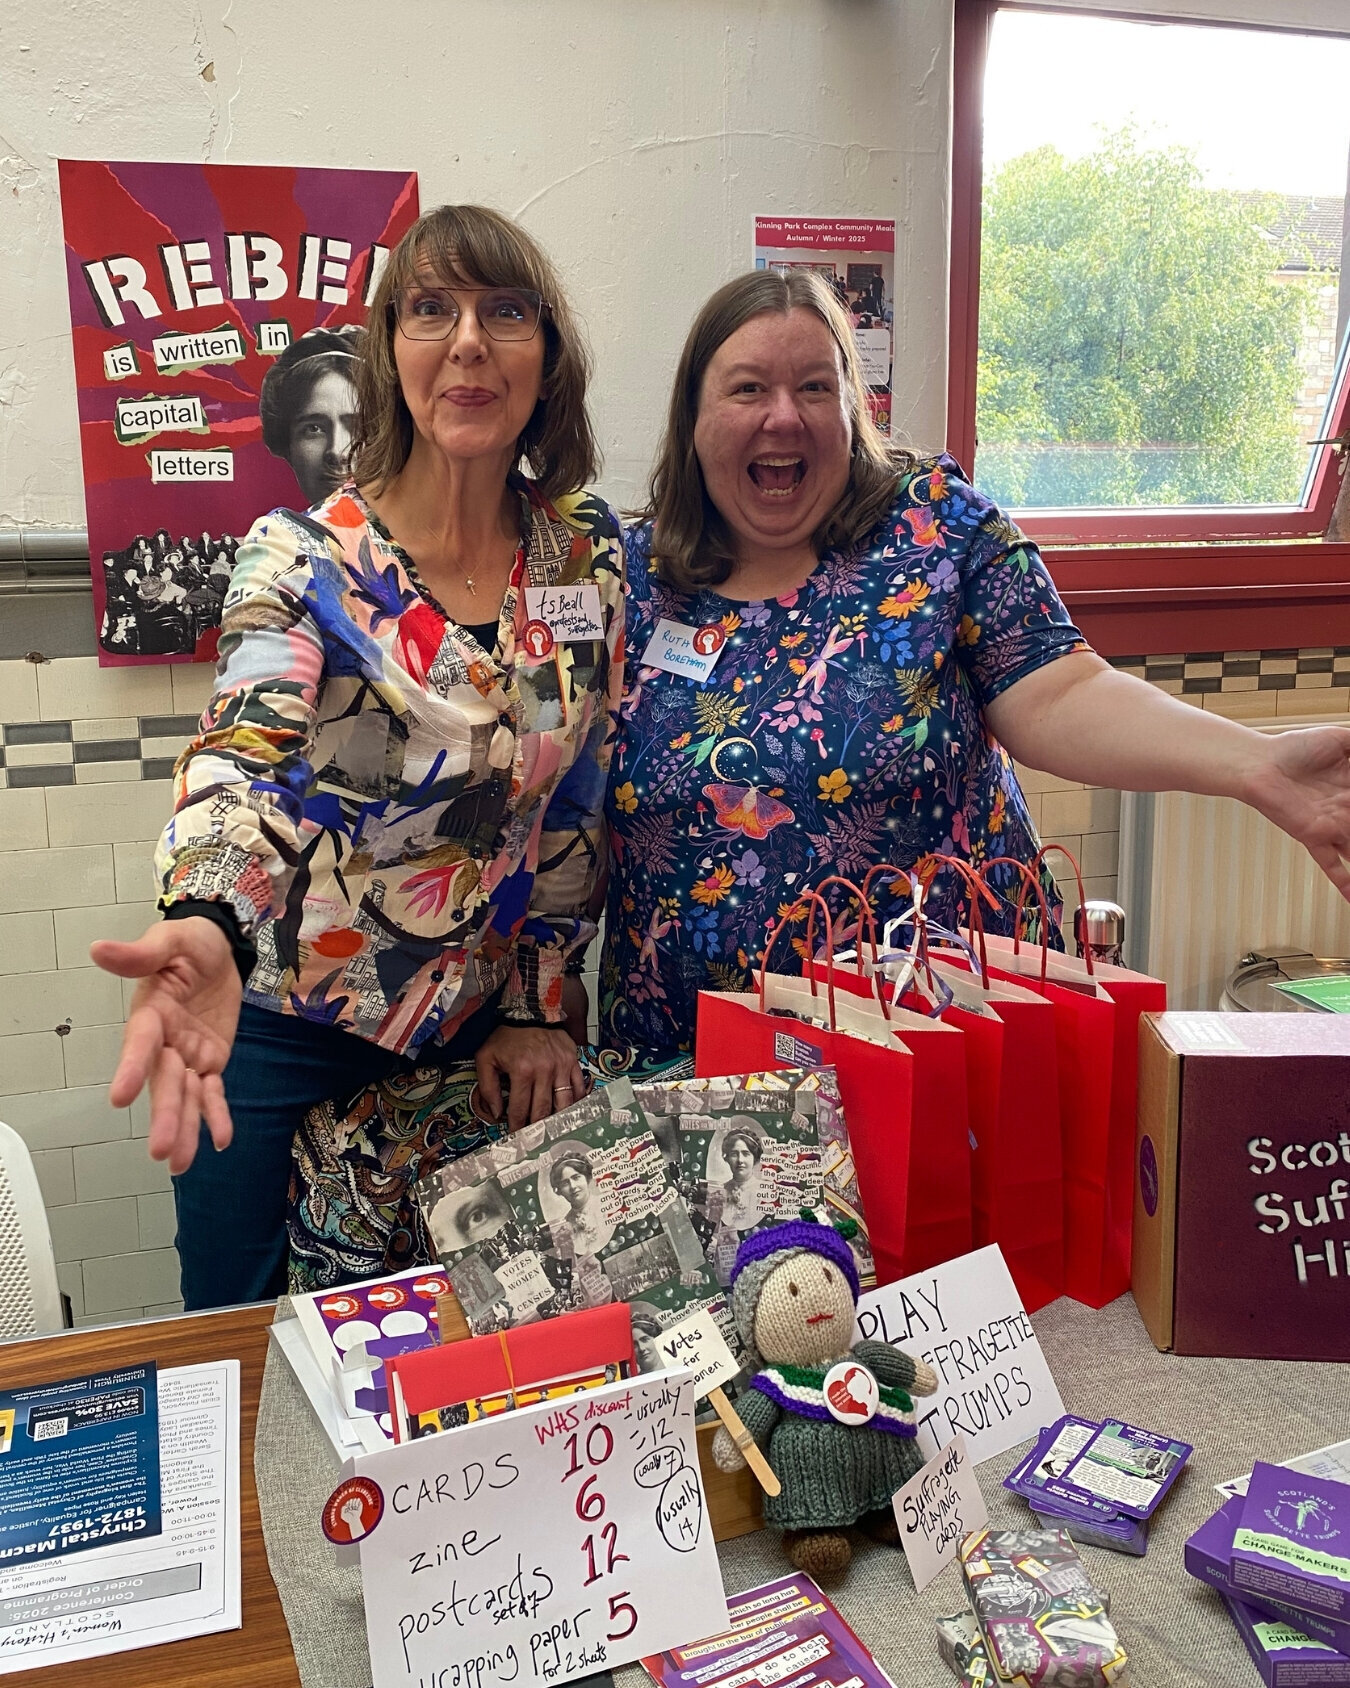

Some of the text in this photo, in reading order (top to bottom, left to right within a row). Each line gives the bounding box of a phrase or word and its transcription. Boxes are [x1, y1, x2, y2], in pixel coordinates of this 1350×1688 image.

[756, 221, 782, 230] Kinning
[803, 222, 832, 231] Complex
[836, 224, 874, 232] Community
[786, 234, 814, 242] Autumn
[822, 234, 846, 242] Winter
[111, 322, 289, 373] is written in
[120, 401, 198, 433] capital
[156, 455, 230, 478] letters
[557, 591, 584, 614] Beall
[662, 630, 690, 648] RUTH
[588, 1150, 602, 1160] We
[600, 1146, 620, 1162] have
[630, 1132, 653, 1149] power
[620, 1152, 628, 1160] of
[1247, 1132, 1350, 1175] Scot
[600, 1180, 613, 1189] the
[614, 1172, 640, 1188] power
[600, 1192, 616, 1204] and
[648, 1174, 664, 1186] and
[600, 1202, 614, 1214] out
[626, 1192, 648, 1207] these
[650, 1186, 662, 1196] we
[625, 1202, 655, 1220] fashion
[1254, 1178, 1350, 1234] Suf
[502, 1256, 532, 1278] VOTES
[508, 1268, 541, 1291] WOMEN
[516, 1287, 552, 1312] CENSUS
[663, 1329, 703, 1358] Votes
[682, 1352, 700, 1366] for
[94, 1373, 146, 1389] EDINBURGH
[112, 1368, 146, 1380] University
[694, 1360, 724, 1385] omen
[74, 1393, 111, 1405] PAPER30
[74, 1397, 139, 1417] SAVE 30%
[918, 1366, 1032, 1451] TRUMPS
[74, 1415, 112, 1428] PAPERBACK
[535, 1404, 580, 1445] WHS
[561, 1418, 674, 1483] 10 12
[127, 1489, 147, 1498] Helen
[392, 1453, 520, 1515] CARDS
[576, 1474, 607, 1522] 6
[1277, 1490, 1336, 1510] SCOTLAND'S
[64, 1502, 82, 1512] Pipes
[93, 1496, 147, 1513] Campaigner
[186, 1498, 220, 1510] Session
[920, 1487, 962, 1542] PLAYING
[8, 1518, 40, 1530] Justice
[40, 1512, 78, 1524] Equality,
[48, 1506, 146, 1537] 1872-1937
[1264, 1508, 1310, 1539] SUFFRAGETTE
[0, 1518, 146, 1560] Chrystal Macm
[936, 1508, 964, 1554] CARDS
[410, 1529, 502, 1575] zine
[580, 1522, 630, 1588] 12
[1242, 1539, 1348, 1574] CHANGE-MAKERS
[1270, 1542, 1290, 1550] GAME
[19, 1559, 62, 1571] Welcome
[3, 1578, 144, 1610] Order of Programme
[12, 1575, 67, 1592] Registration
[8, 1591, 134, 1621] Conference 2025:
[398, 1553, 553, 1674] postcards
[493, 1601, 518, 1626] set
[728, 1605, 752, 1617] which
[762, 1594, 781, 1607] long
[780, 1588, 796, 1598] has
[14, 1610, 115, 1636] SCOTLAND
[730, 1622, 744, 1630] her
[746, 1612, 772, 1626] people
[773, 1604, 792, 1615] shall
[1306, 1616, 1336, 1638] TRUMPS
[0, 1619, 122, 1647] Women's History
[530, 1608, 592, 1676] paper
[605, 1591, 639, 1642] 5
[684, 1642, 717, 1658] brought
[716, 1640, 726, 1648] to
[726, 1636, 740, 1646] the
[740, 1632, 754, 1642] bar
[755, 1627, 764, 1636] of
[542, 1660, 562, 1682] for
[565, 1652, 578, 1674] 2
[728, 1636, 827, 1688] can I do to help
[760, 1672, 782, 1685] the
